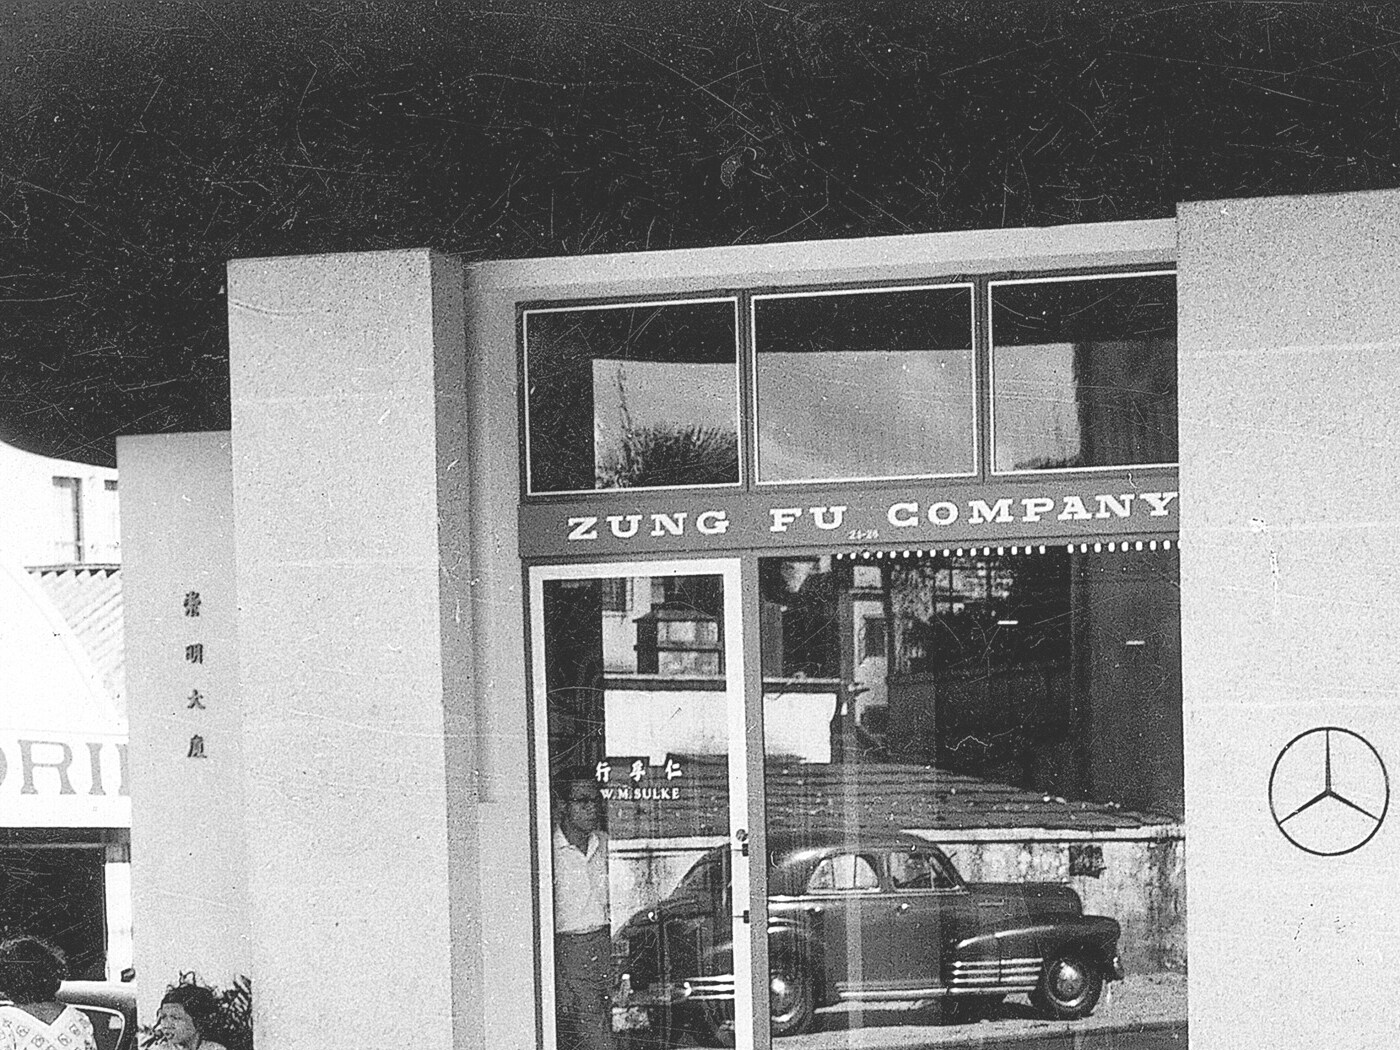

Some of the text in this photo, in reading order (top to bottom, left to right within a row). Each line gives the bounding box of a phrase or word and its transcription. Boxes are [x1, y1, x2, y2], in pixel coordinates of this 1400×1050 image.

[568, 491, 1178, 540] ZUNG FU COMPANY
